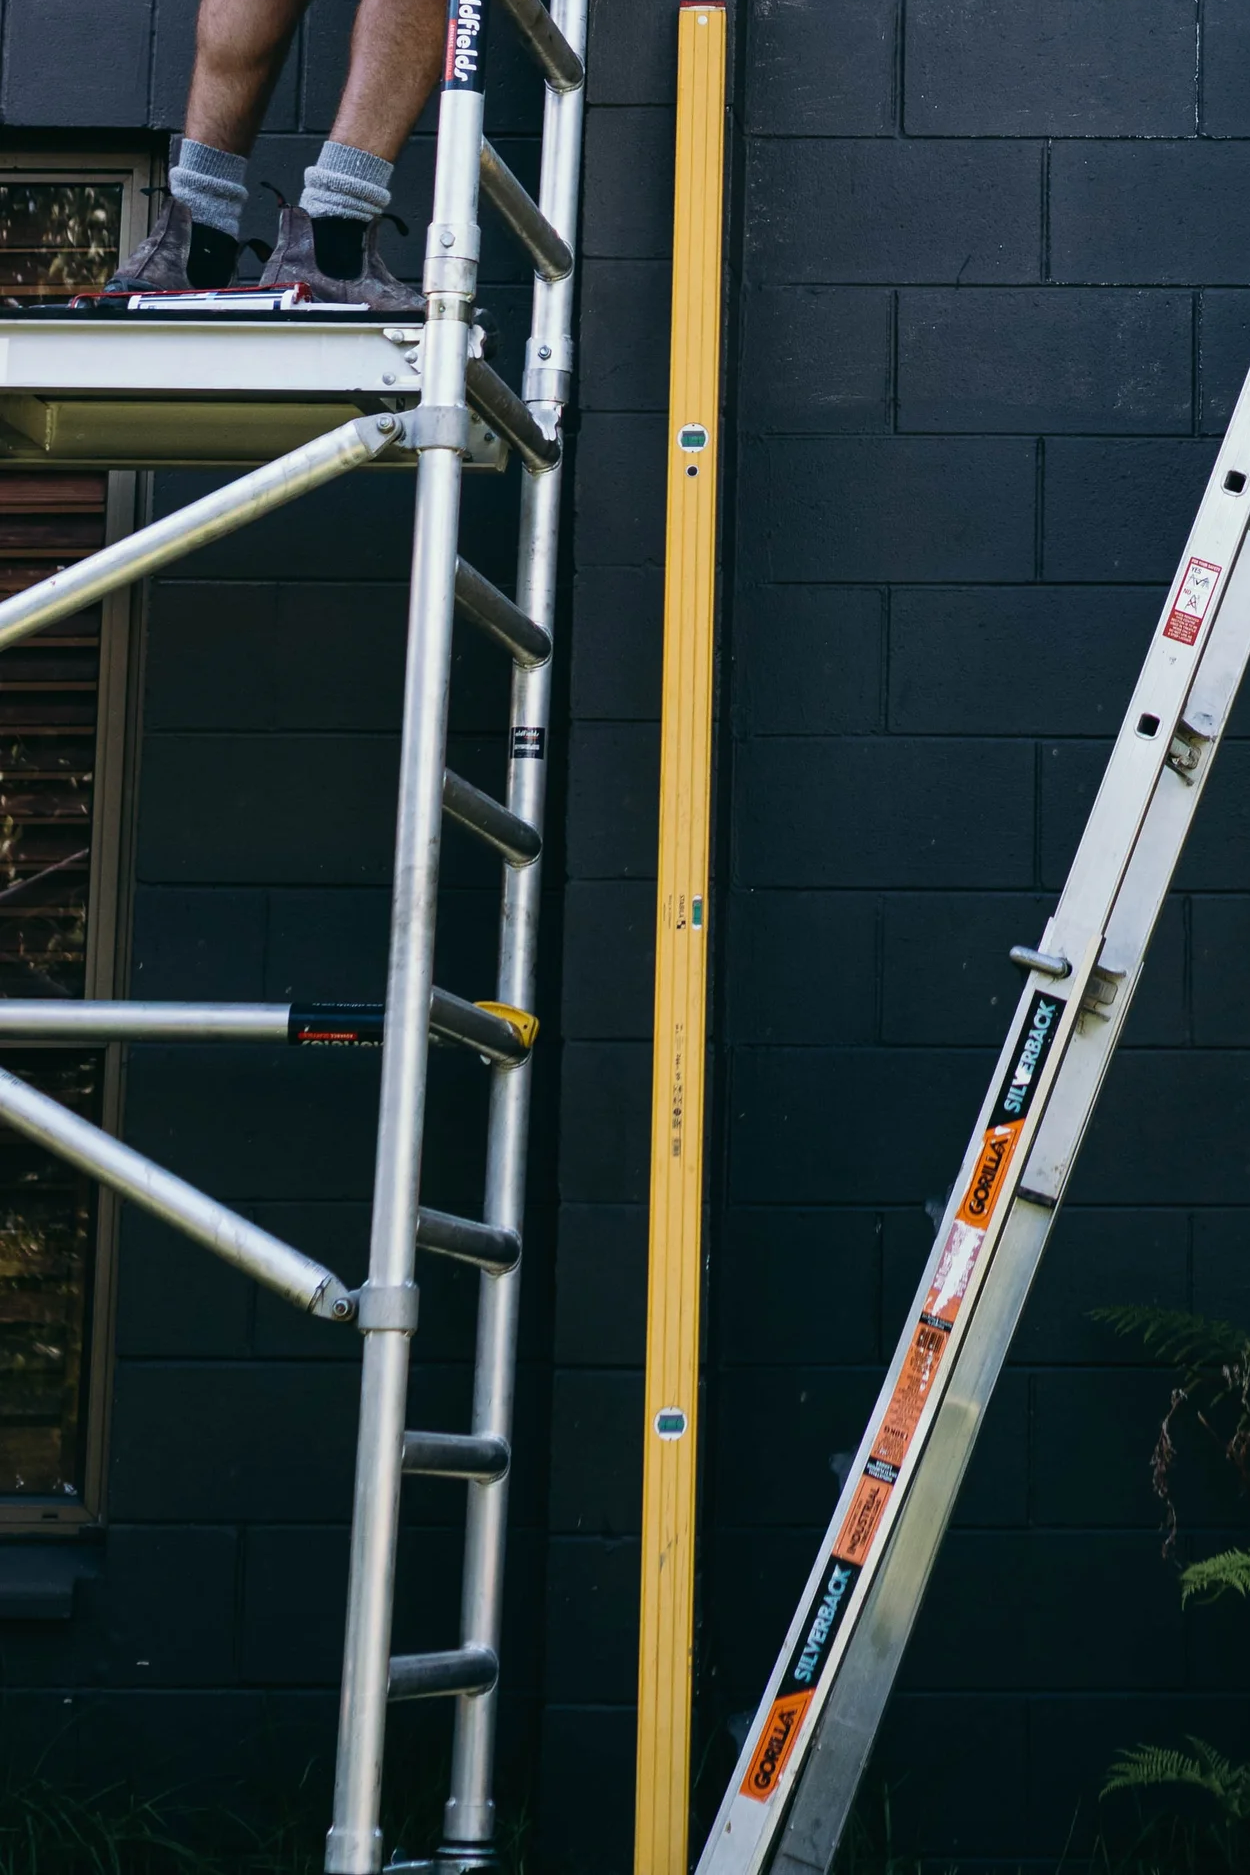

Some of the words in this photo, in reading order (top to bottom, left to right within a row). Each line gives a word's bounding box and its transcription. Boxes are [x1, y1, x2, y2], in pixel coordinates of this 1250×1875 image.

[1191, 566, 1202, 574] YES
[969, 1137, 1008, 1215] GORILLA
[794, 1563, 852, 1683] SILVERBACK
[754, 1709, 798, 1790] GORILLA
